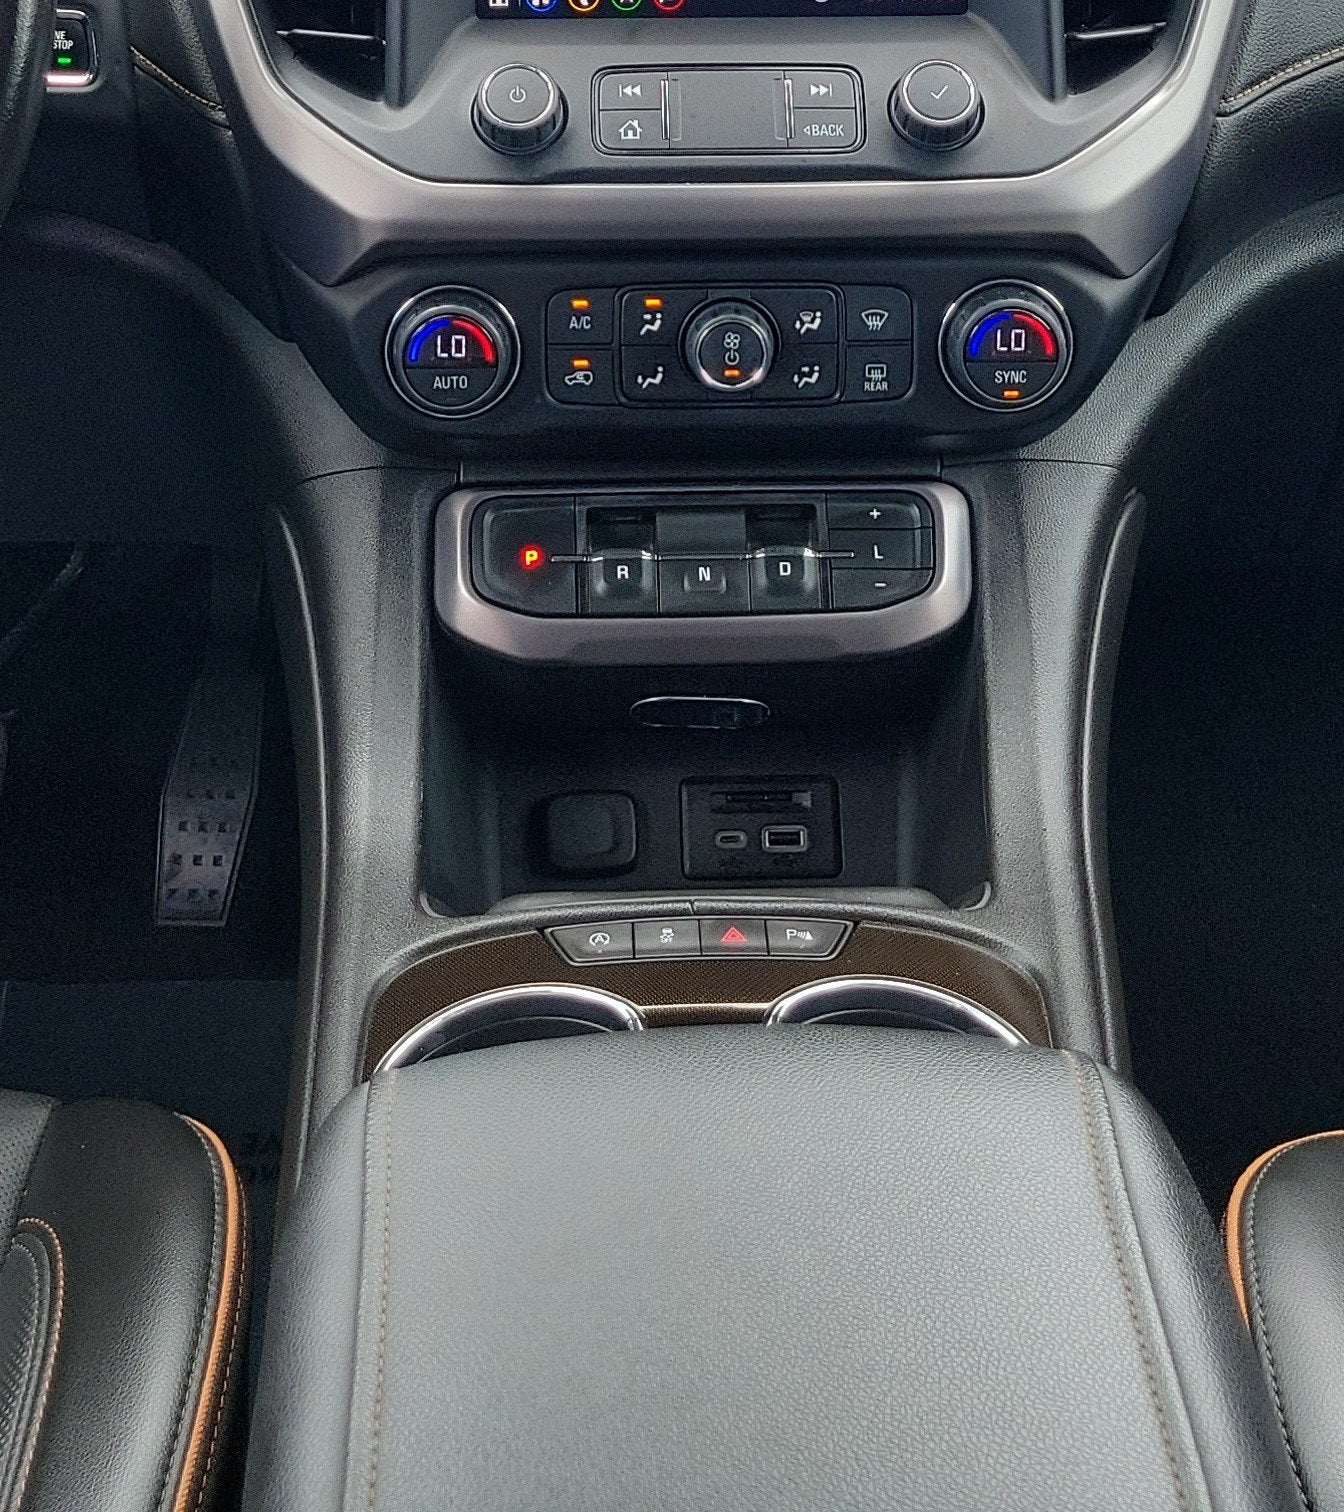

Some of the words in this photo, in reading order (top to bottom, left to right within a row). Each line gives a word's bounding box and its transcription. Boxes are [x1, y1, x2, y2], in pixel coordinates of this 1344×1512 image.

[811, 124, 845, 136] BACK
[569, 316, 592, 330] A/C
[437, 335, 466, 358] LO
[996, 328, 1026, 351] LO
[433, 376, 468, 389] AUTO
[994, 370, 1027, 384] SYNC
[864, 381, 888, 391] REAR
[525, 550, 539, 566] P
[874, 545, 884, 559] L
[617, 565, 630, 579] R
[698, 566, 711, 581] N
[779, 561, 792, 576] D
